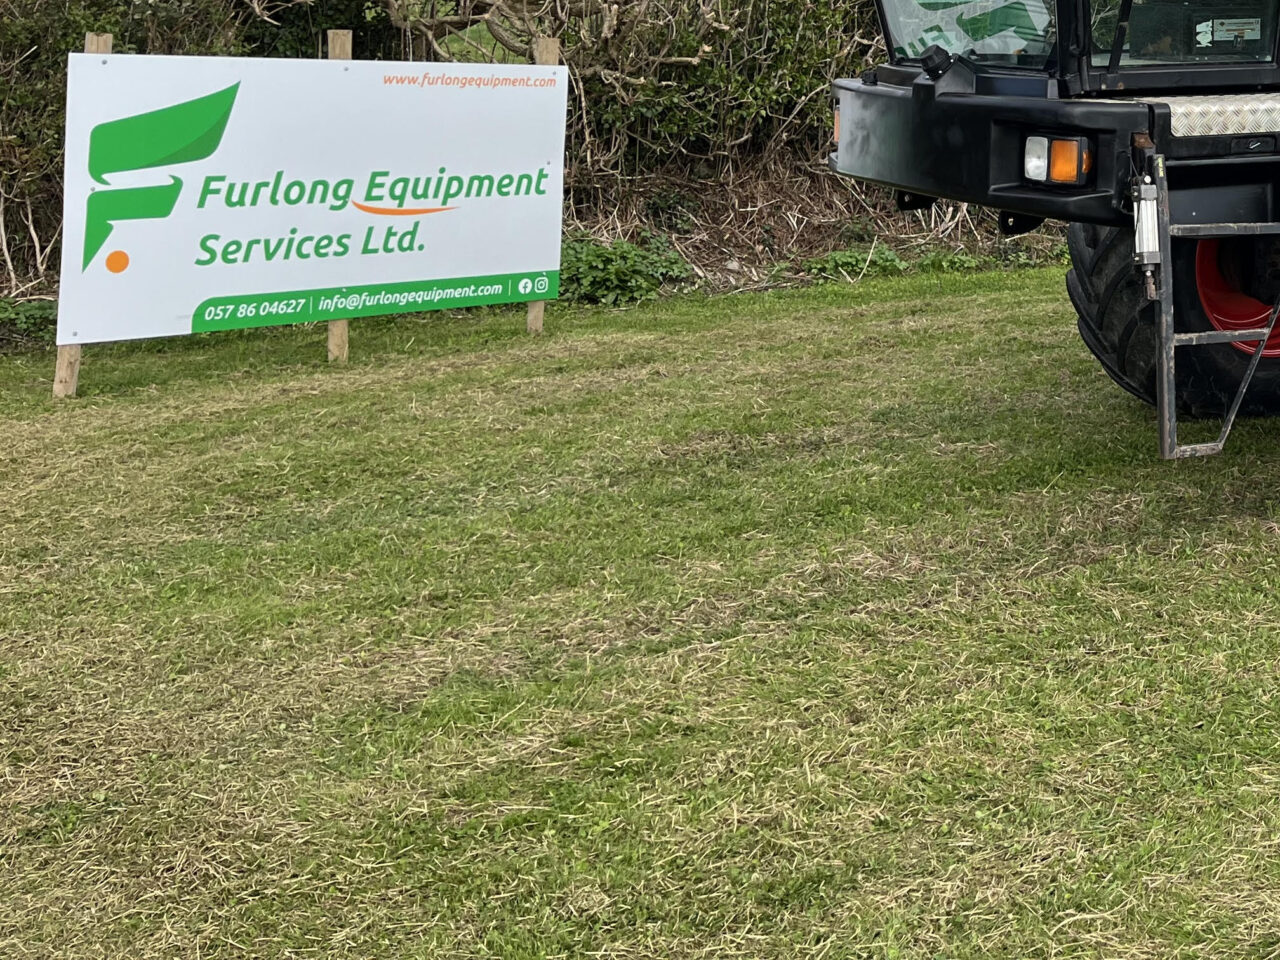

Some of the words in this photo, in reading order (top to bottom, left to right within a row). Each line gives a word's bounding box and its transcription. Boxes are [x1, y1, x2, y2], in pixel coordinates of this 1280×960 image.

[383, 72, 557, 89] www.furlongequipment.com
[196, 170, 355, 211] Furlong
[364, 166, 549, 208] Equipment
[194, 227, 352, 266] Services
[361, 220, 425, 255] Ltd.
[204, 305, 235, 321] 057
[237, 302, 257, 318] 86
[259, 298, 306, 315] 04627
[318, 283, 503, 312] info@furlongequipment.com
